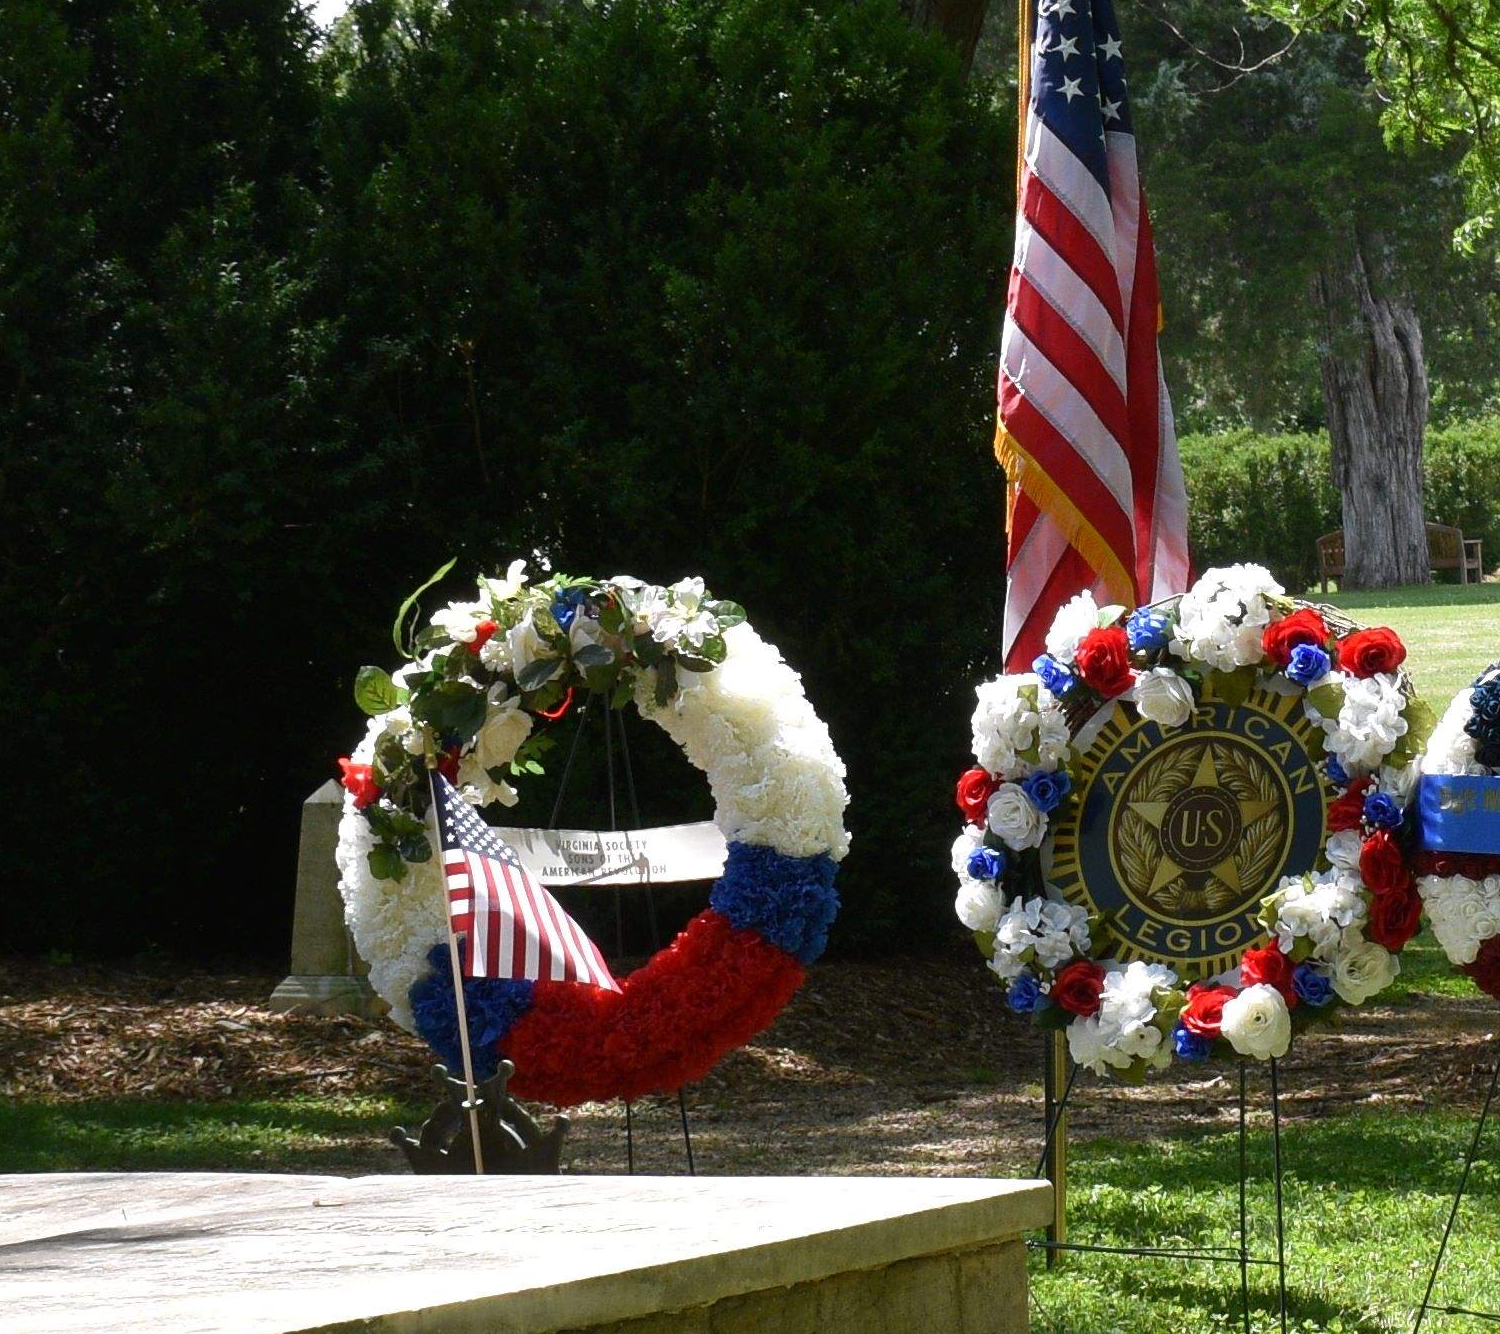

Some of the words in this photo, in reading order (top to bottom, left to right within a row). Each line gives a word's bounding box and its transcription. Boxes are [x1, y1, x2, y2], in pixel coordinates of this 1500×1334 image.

[1102, 706, 1315, 795] AMERICAN
[568, 854, 595, 865] SONS
[618, 854, 635, 864] TH
